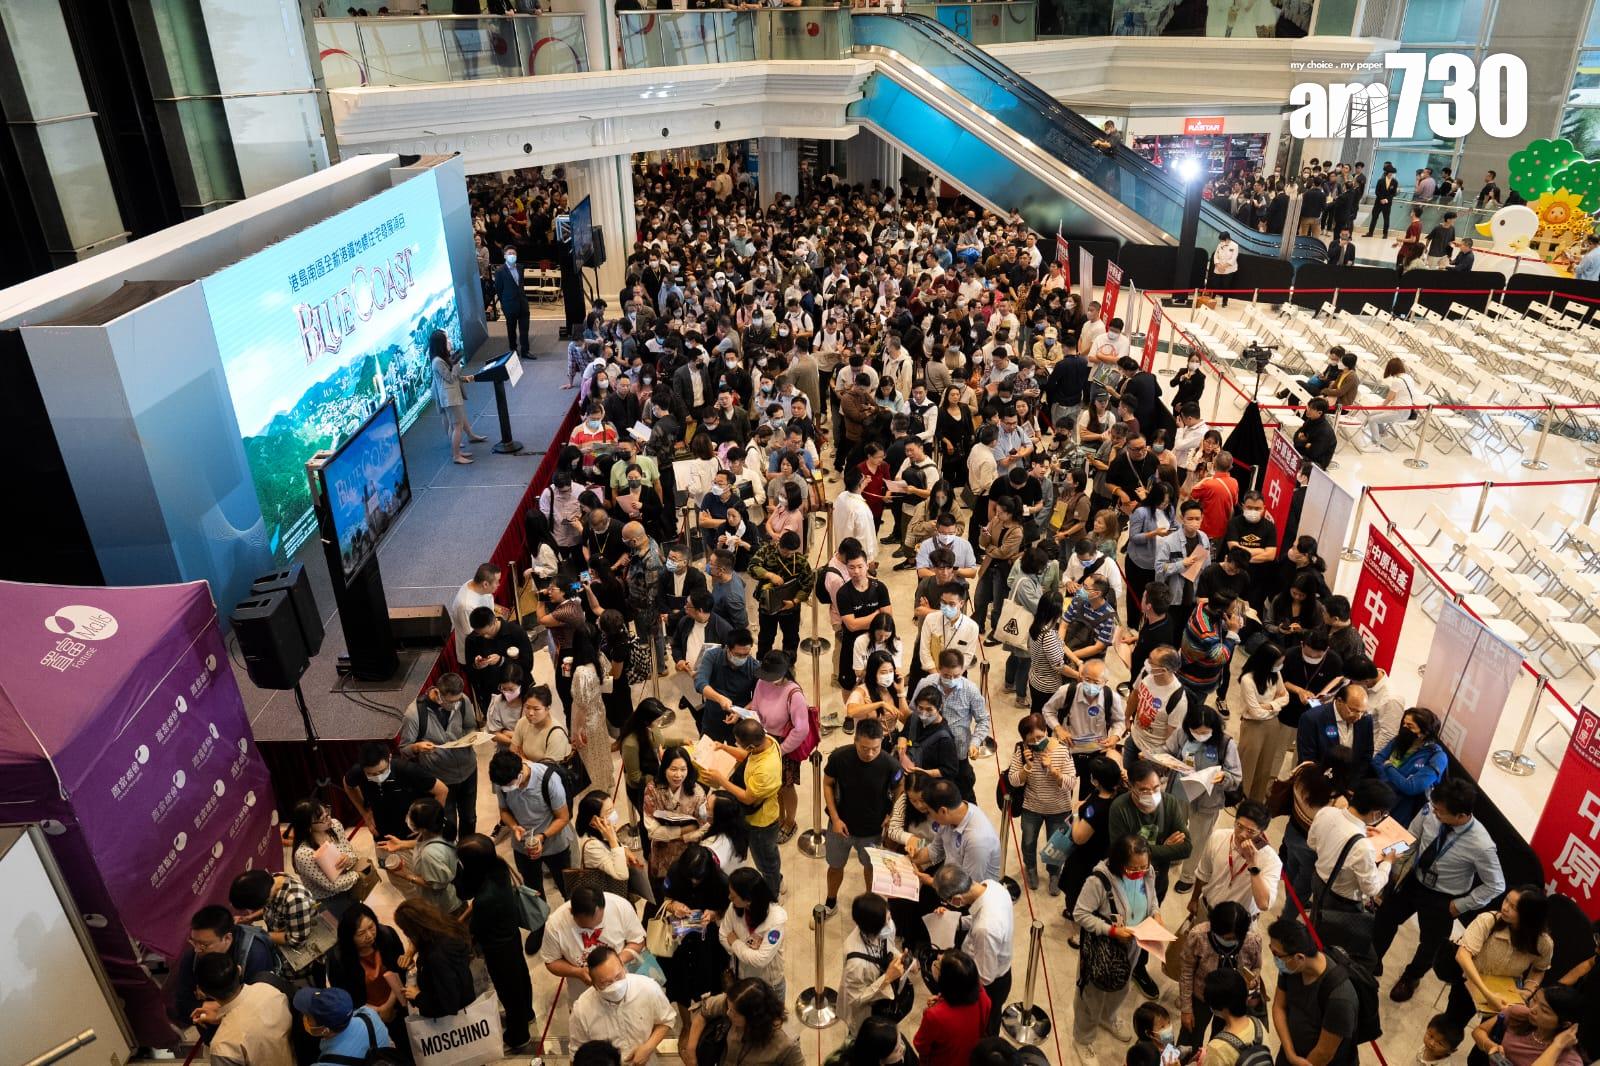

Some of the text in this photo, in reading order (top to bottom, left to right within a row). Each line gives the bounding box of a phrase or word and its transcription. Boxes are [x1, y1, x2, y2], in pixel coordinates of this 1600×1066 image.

[296, 247, 415, 365] BLUE COAST
[1372, 544, 1409, 590] 中原地產
[75, 614, 112, 640] Malls
[421, 1019, 490, 1057] MOSCHINO
